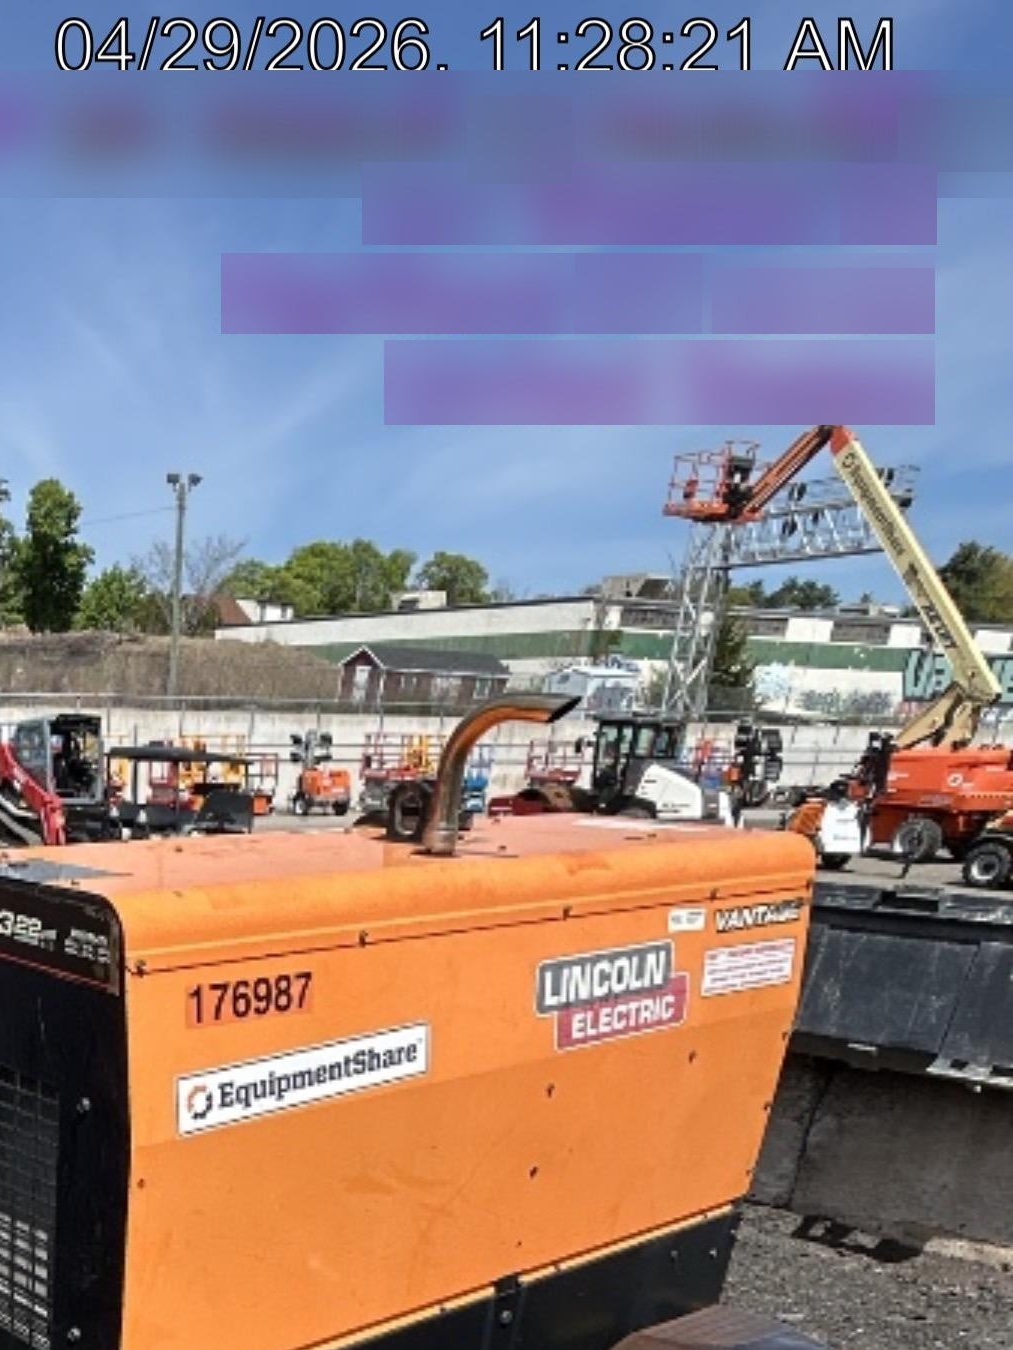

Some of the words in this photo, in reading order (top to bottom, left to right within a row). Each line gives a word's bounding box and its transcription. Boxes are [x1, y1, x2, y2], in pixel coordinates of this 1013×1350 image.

[188, 972, 312, 1024] 176987
[544, 951, 666, 1006] LINCOLN
[571, 995, 675, 1039] ELECTRIC
[218, 1042, 418, 1109] EquipmentShare
